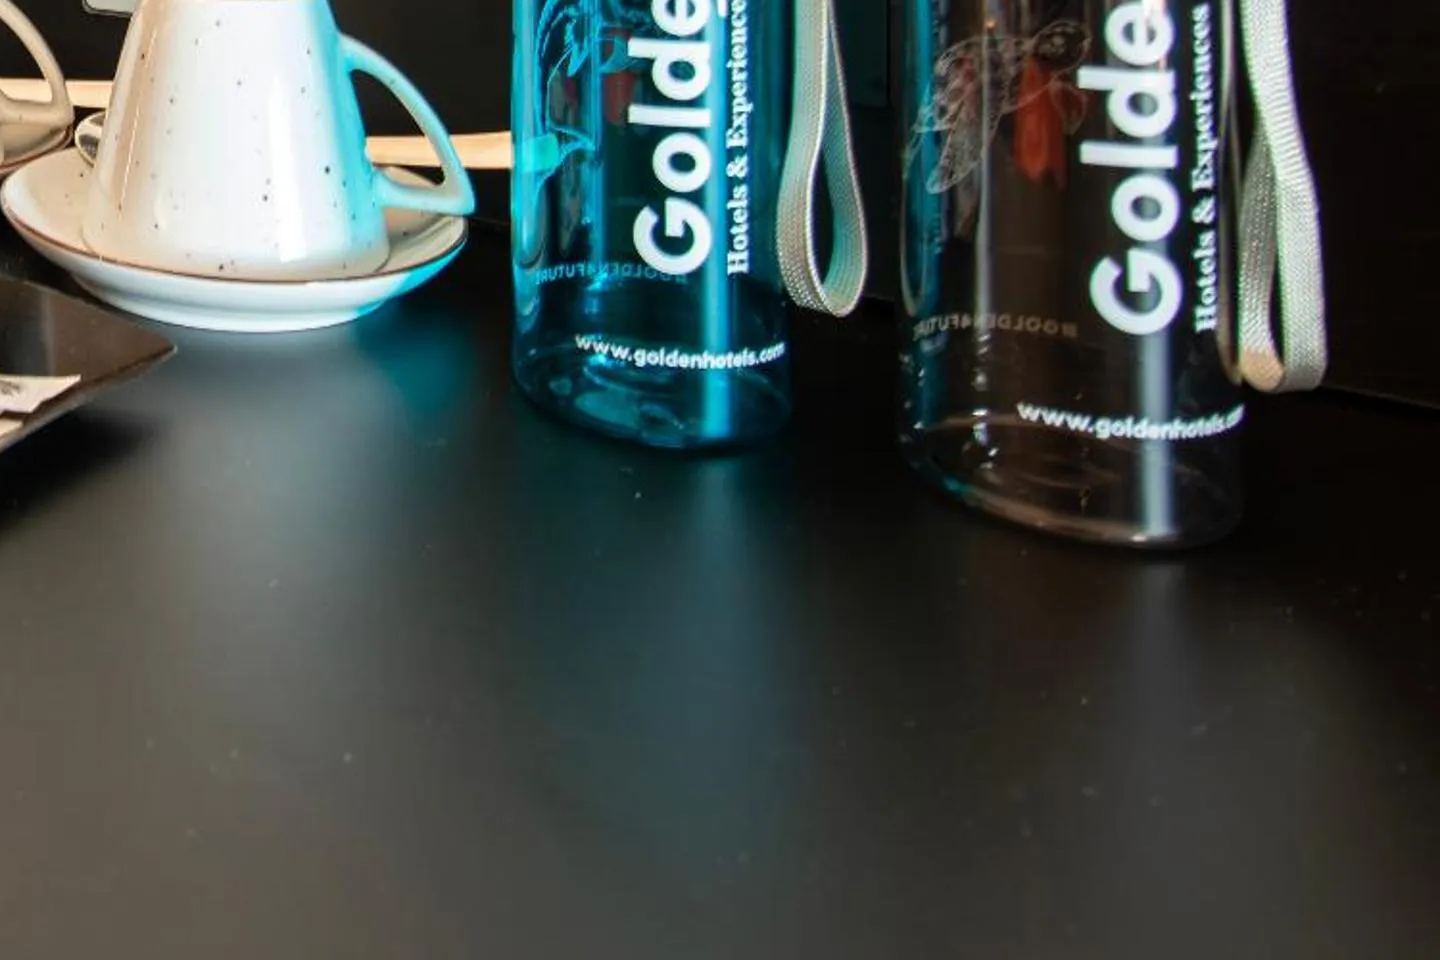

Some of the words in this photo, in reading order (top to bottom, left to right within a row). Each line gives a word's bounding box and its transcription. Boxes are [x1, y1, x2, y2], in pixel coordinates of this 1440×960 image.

[1189, 2, 1218, 192] Experiences
[726, 154, 748, 179] &
[726, 185, 750, 276] Hotels
[1192, 196, 1216, 225] &
[1193, 230, 1218, 333] Hotels
[574, 334, 786, 369] www.goldenhotels.com
